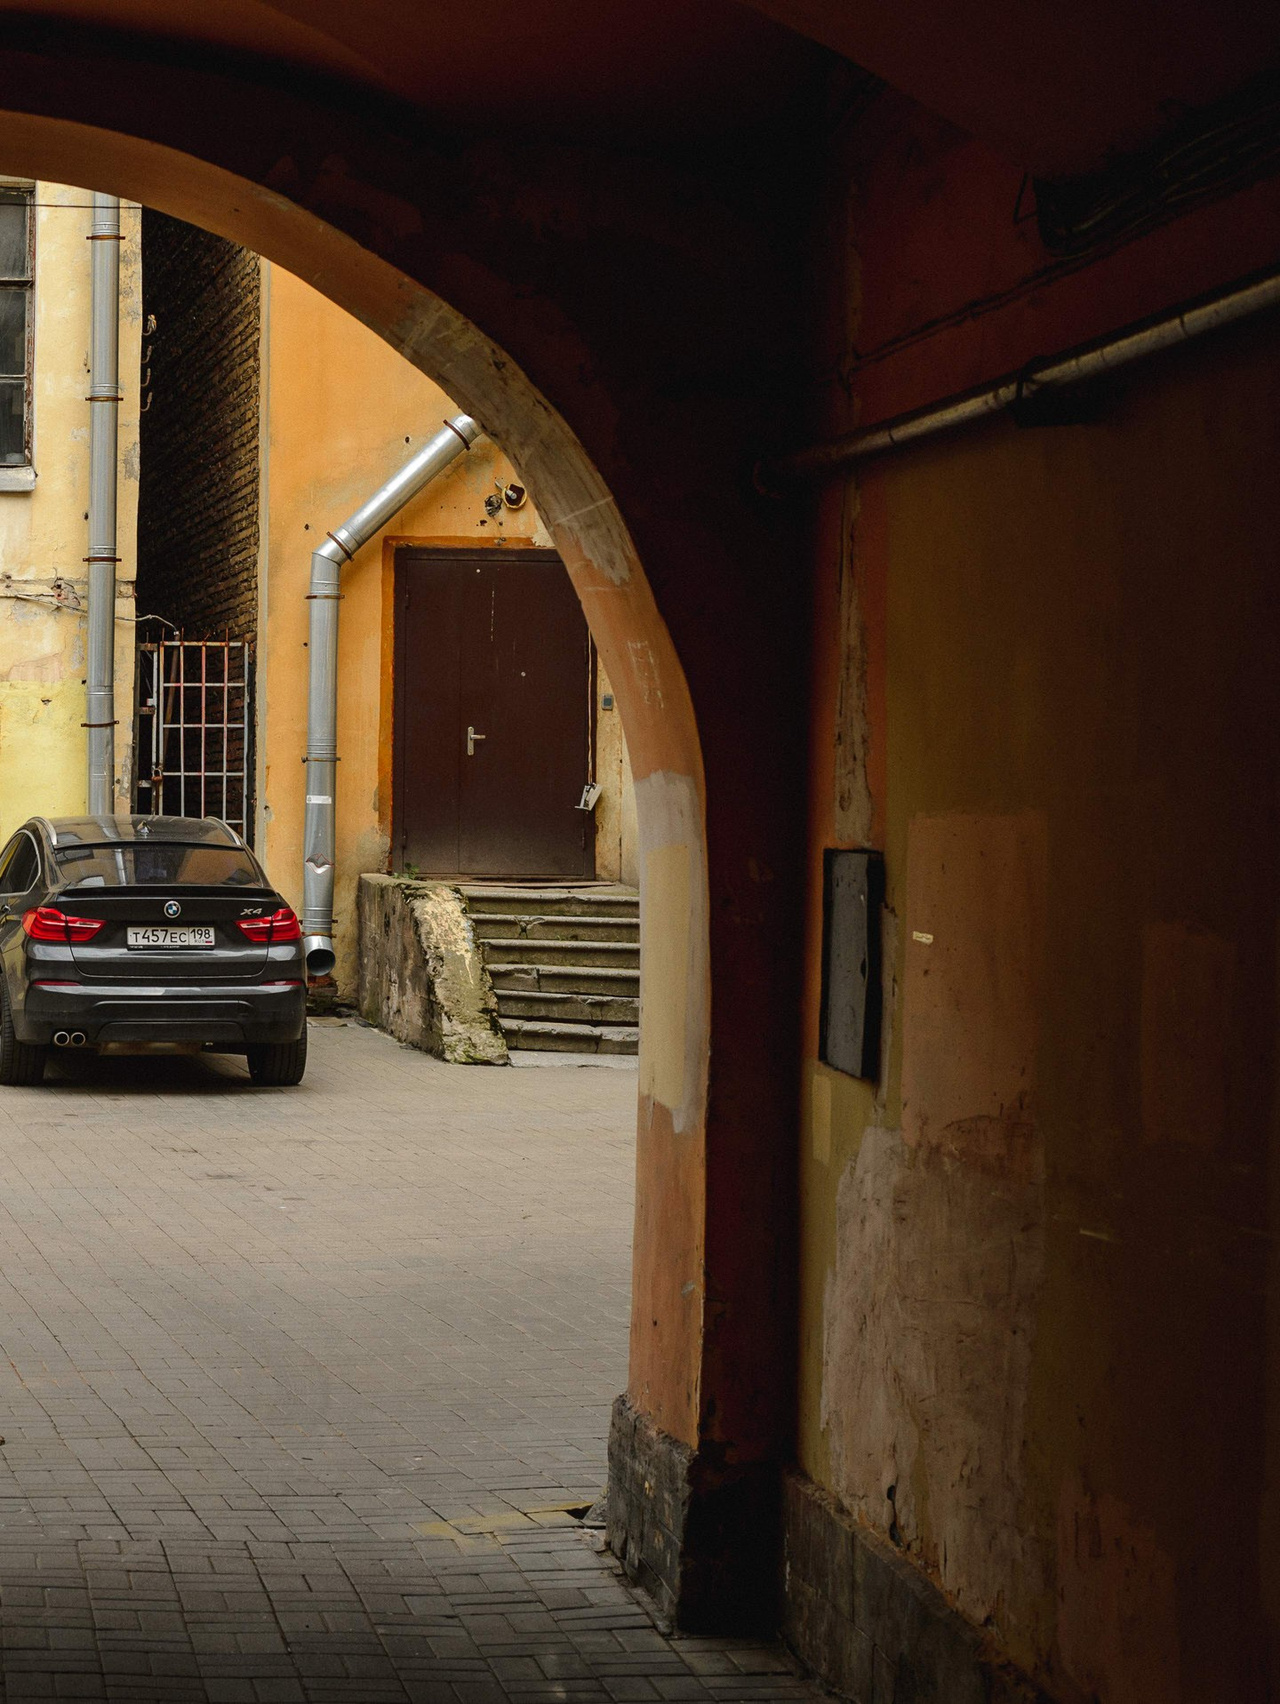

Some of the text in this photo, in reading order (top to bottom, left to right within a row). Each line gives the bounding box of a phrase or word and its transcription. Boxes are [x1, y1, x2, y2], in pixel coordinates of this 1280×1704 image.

[240, 908, 262, 916] X4
[132, 928, 211, 943] T457EC 198
